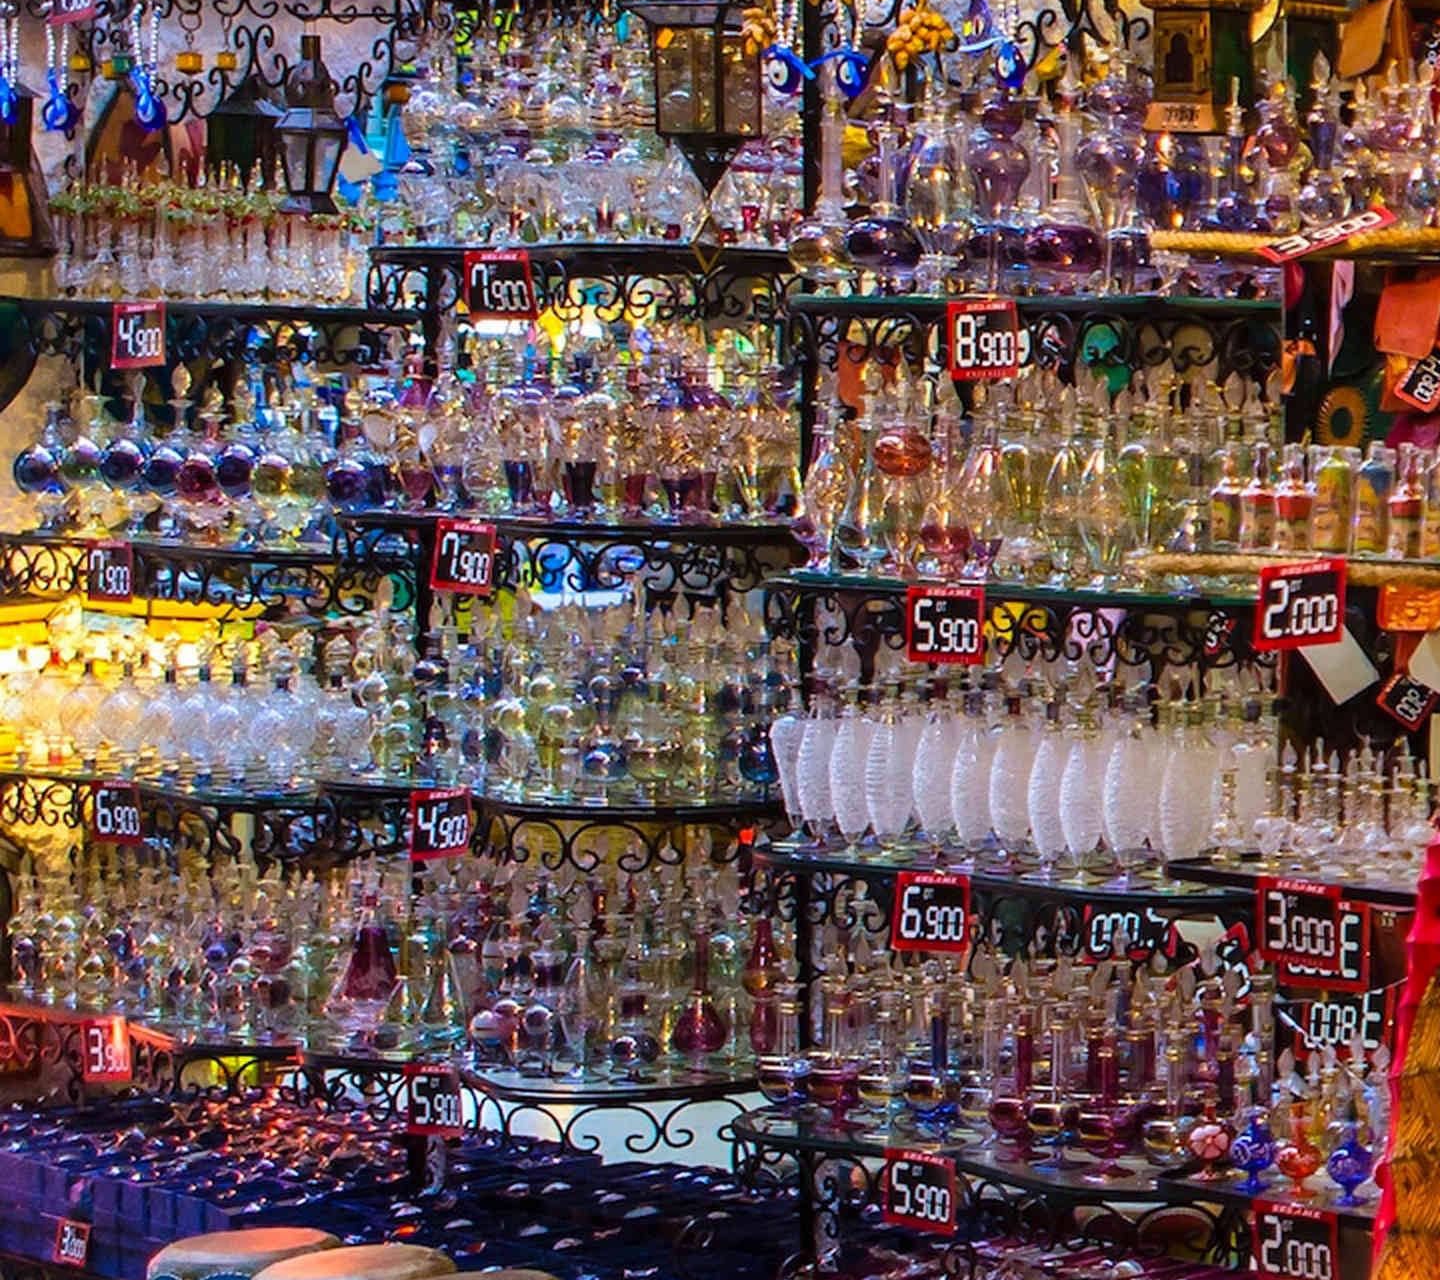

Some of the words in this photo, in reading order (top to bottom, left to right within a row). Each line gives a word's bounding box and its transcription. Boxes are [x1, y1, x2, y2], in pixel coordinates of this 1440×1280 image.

[956, 314, 1015, 367] 8.900
[914, 598, 979, 653] 5.900
[1264, 579, 1339, 639] 2.000
[900, 885, 964, 940] 6.900
[1268, 890, 1334, 956] 3.000
[892, 1161, 951, 1223] 5.900
[1262, 1214, 1332, 1280] 2.000
